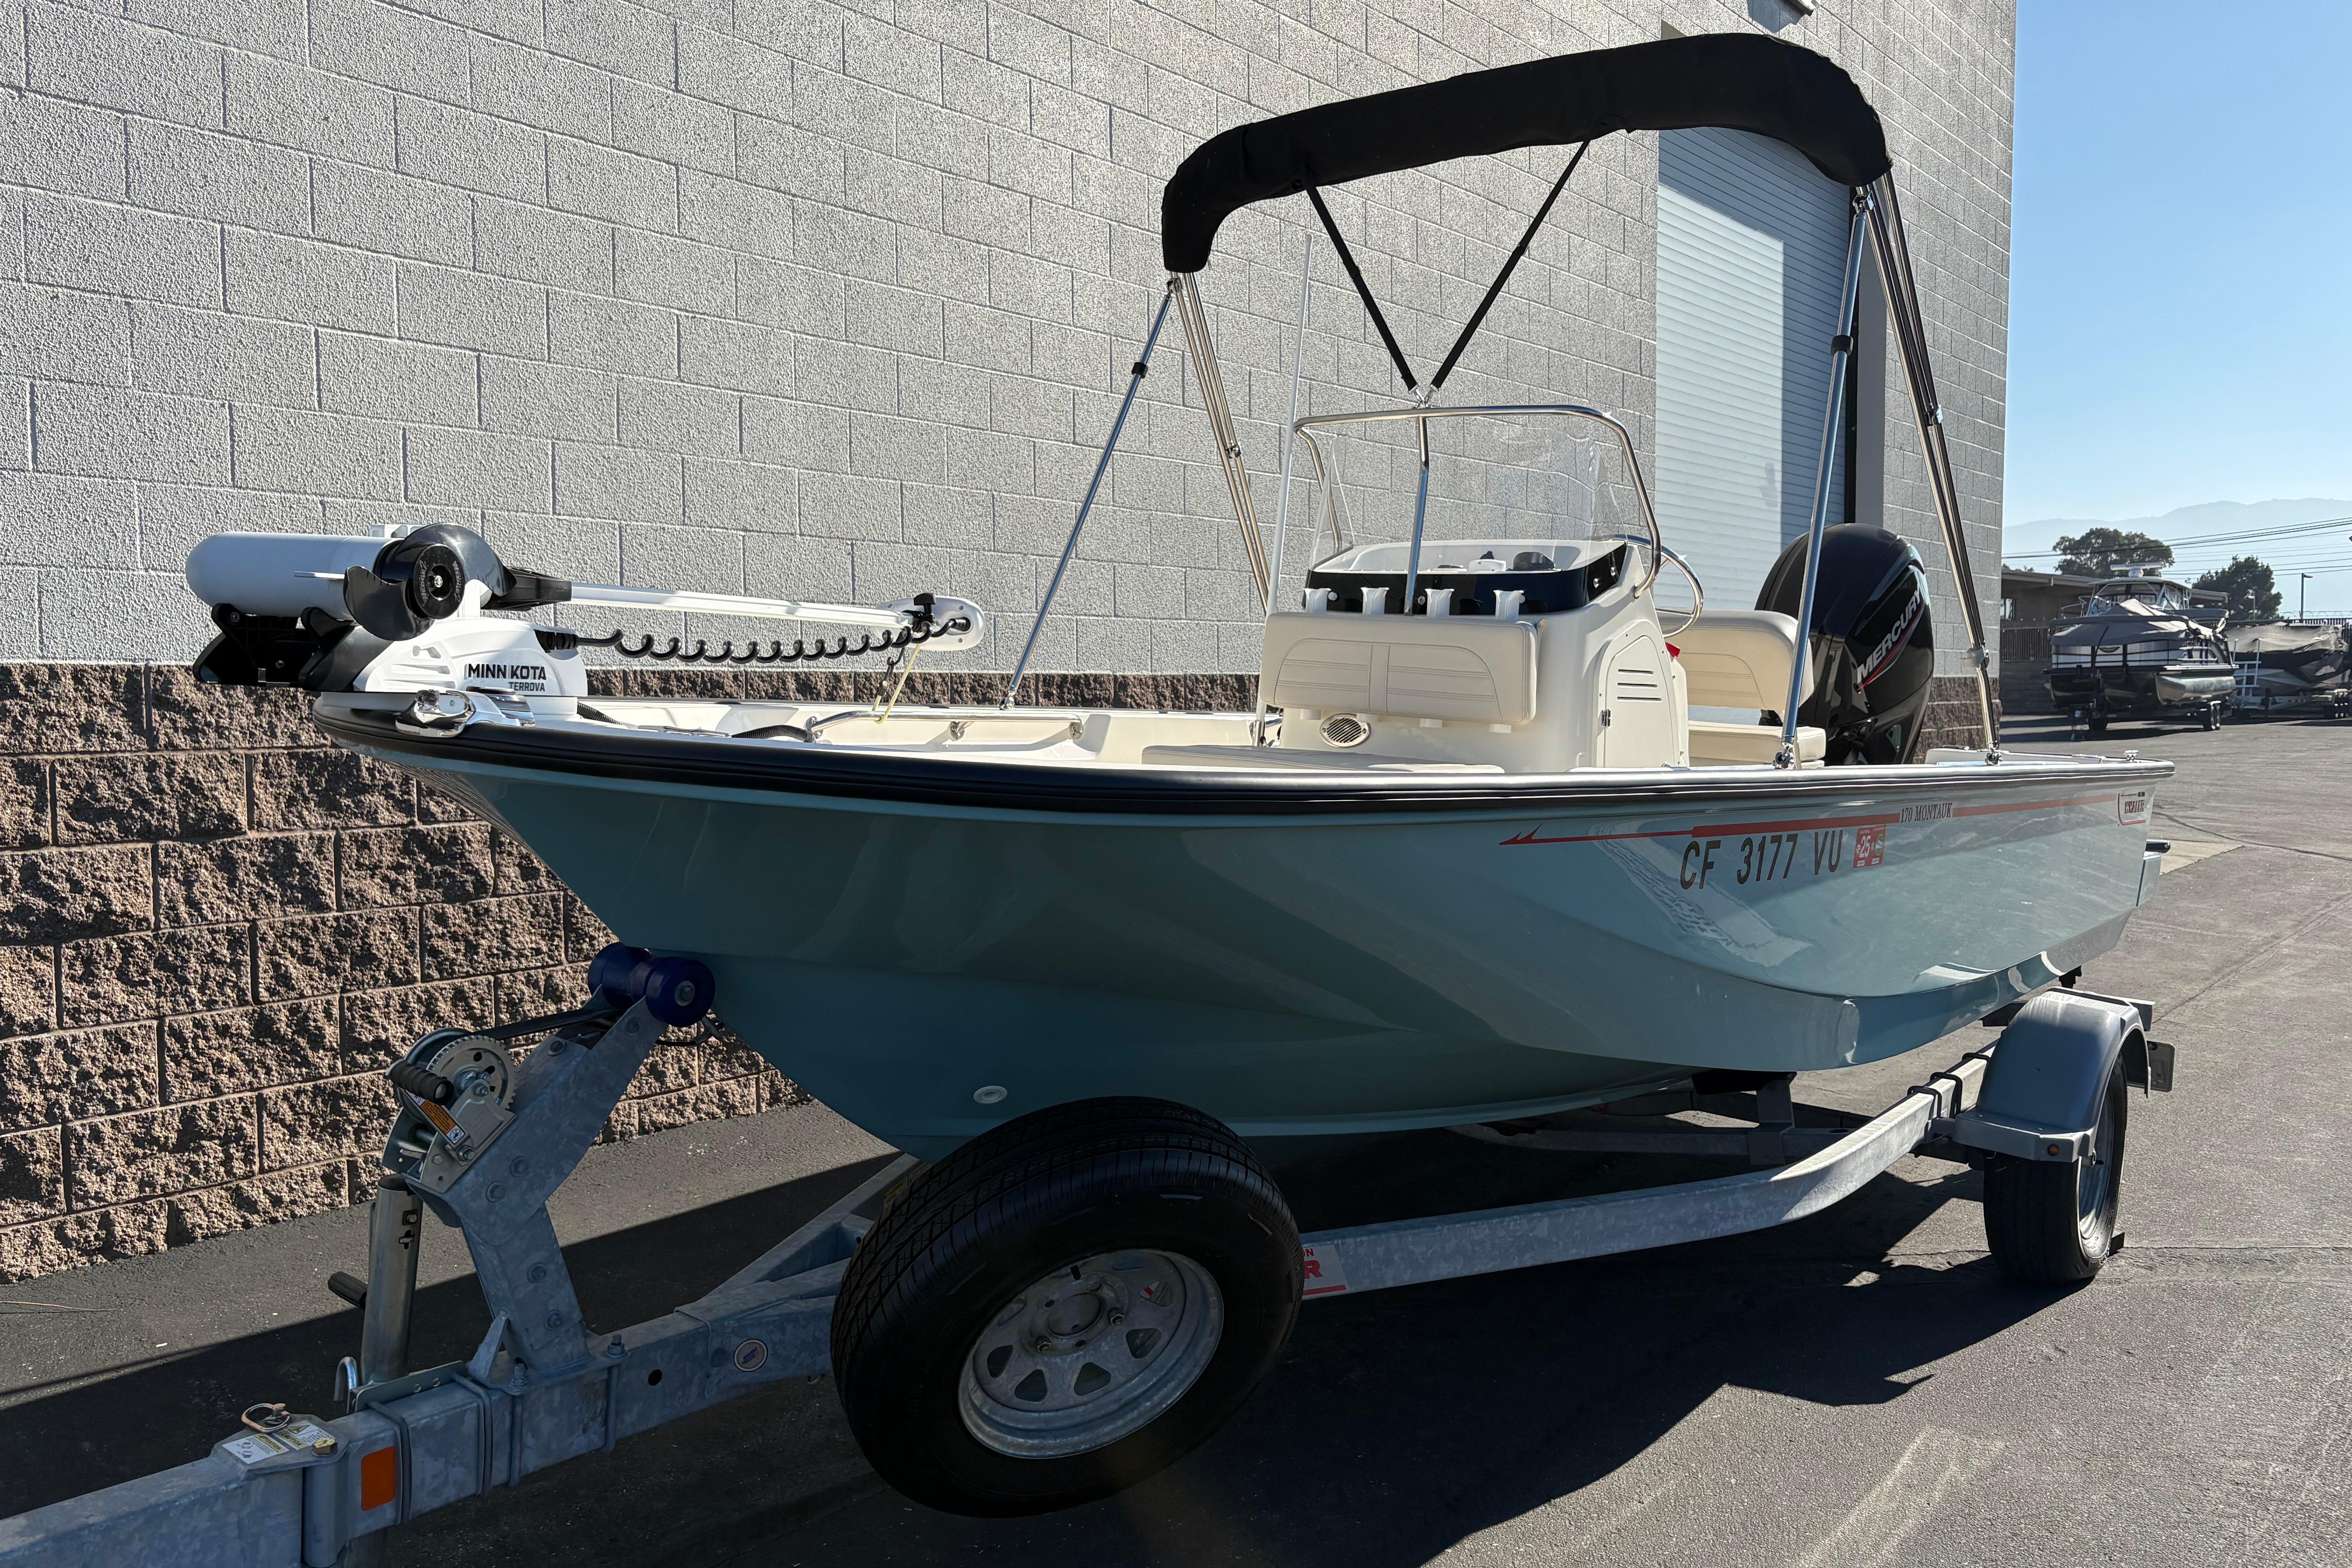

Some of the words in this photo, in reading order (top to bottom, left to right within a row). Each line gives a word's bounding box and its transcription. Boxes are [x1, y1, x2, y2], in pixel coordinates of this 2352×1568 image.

[1857, 585, 1921, 684] MERCURY
[468, 663, 507, 679] MINN
[511, 665, 547, 680] KOTA
[509, 681, 546, 692] TERROVA
[1900, 807, 1913, 823] 170
[1914, 803, 1952, 821] MONTAUK
[1859, 835, 1871, 858] 25
[1680, 840, 1722, 890] CF
[1737, 833, 1798, 885] 3177
[1814, 830, 1843, 875] VU
